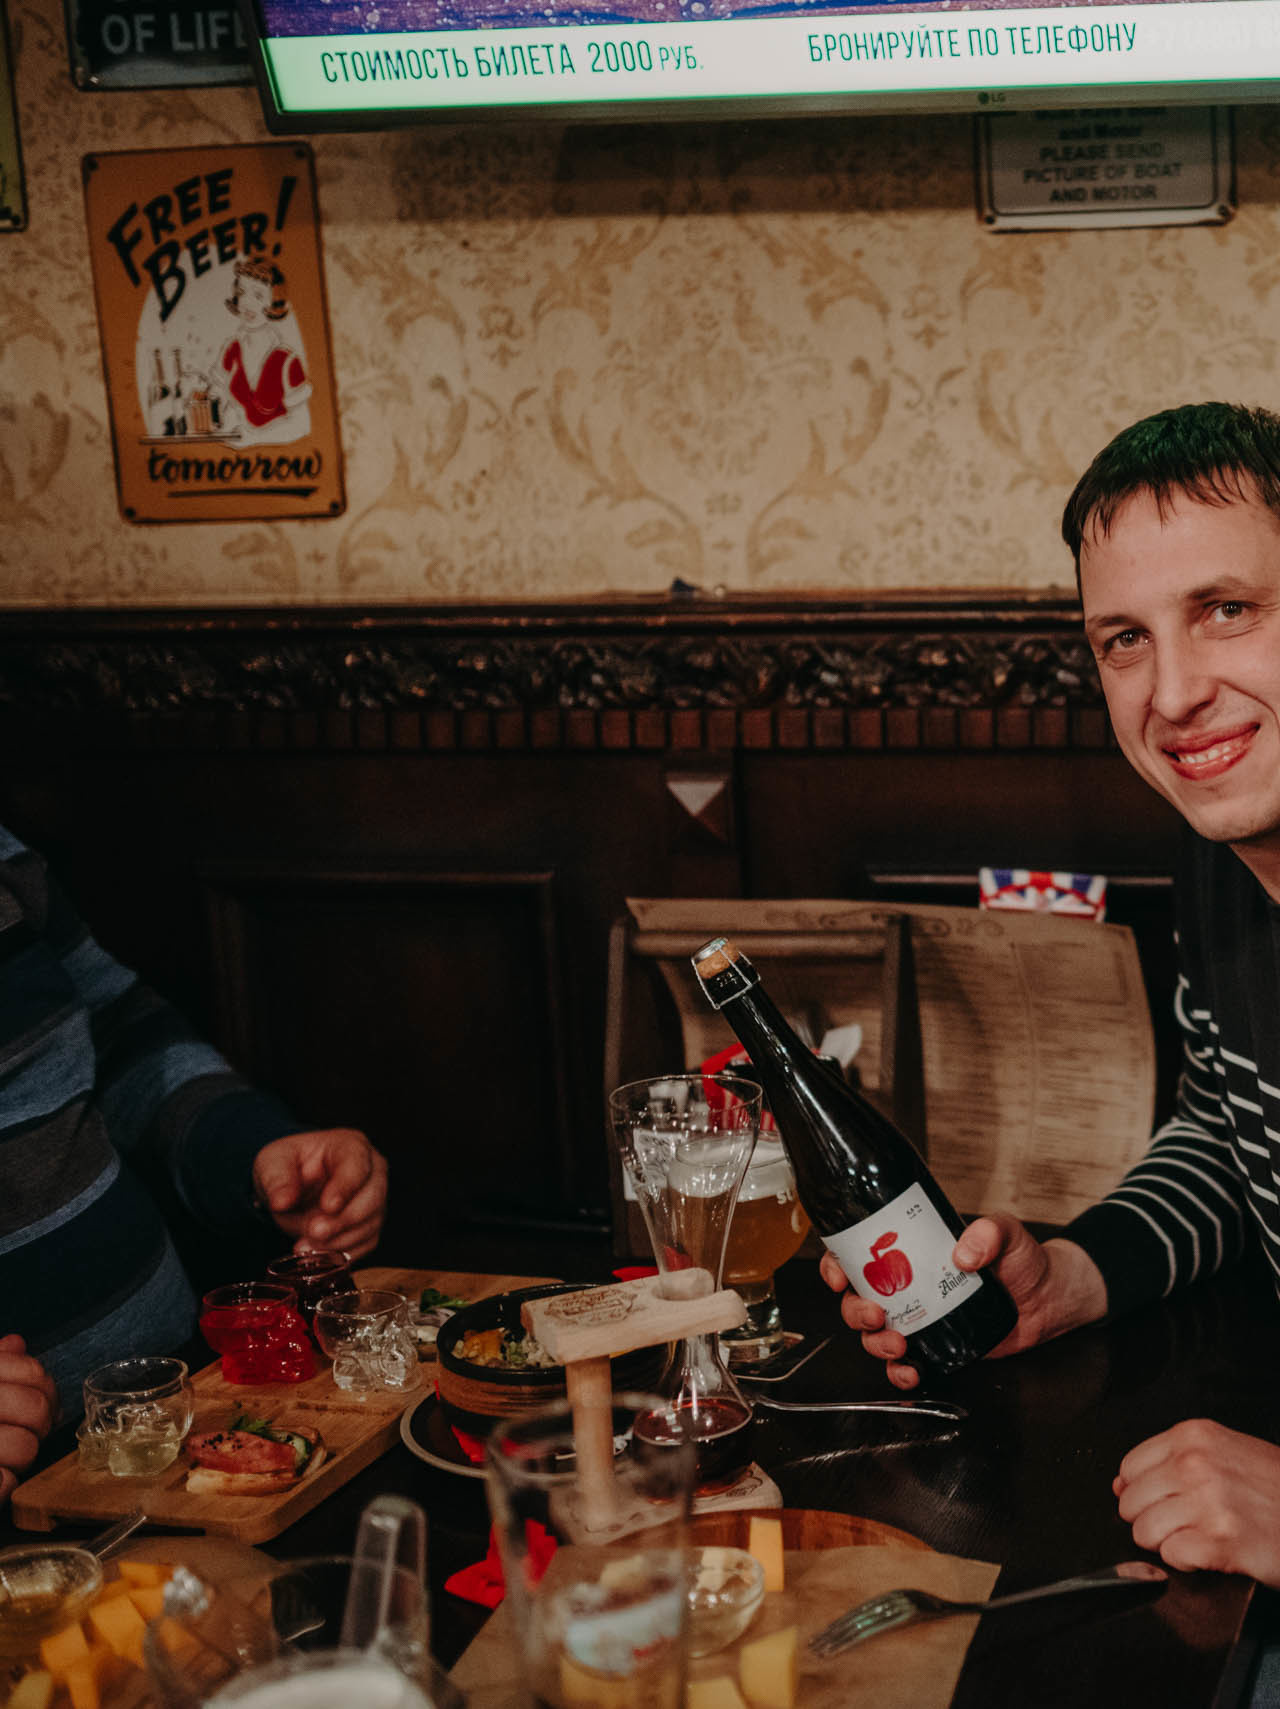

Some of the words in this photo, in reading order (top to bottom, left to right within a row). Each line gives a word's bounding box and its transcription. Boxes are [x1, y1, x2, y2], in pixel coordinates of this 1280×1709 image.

[101, 13, 156, 54] OF
[807, 24, 961, 62] БРОНИРУЙТЕ
[968, 27, 999, 56] ПО
[1005, 22, 1137, 55] ТЕЛЕФОНУ
[320, 47, 469, 83] СТОИМОСТЬ
[474, 43, 576, 77] БИЛЕТА
[587, 40, 653, 73] 2000
[659, 45, 705, 71] РУБ.
[1023, 165, 1099, 184] PICTURE
[1104, 163, 1128, 179] OF
[1134, 162, 1184, 178] BOAT
[1039, 144, 1109, 162] PLEASE
[1049, 187, 1088, 203] AND
[1092, 185, 1158, 201] MOTOR
[107, 168, 233, 288] FREE
[143, 175, 297, 323] BEER!
[148, 447, 322, 481] tomorrow
